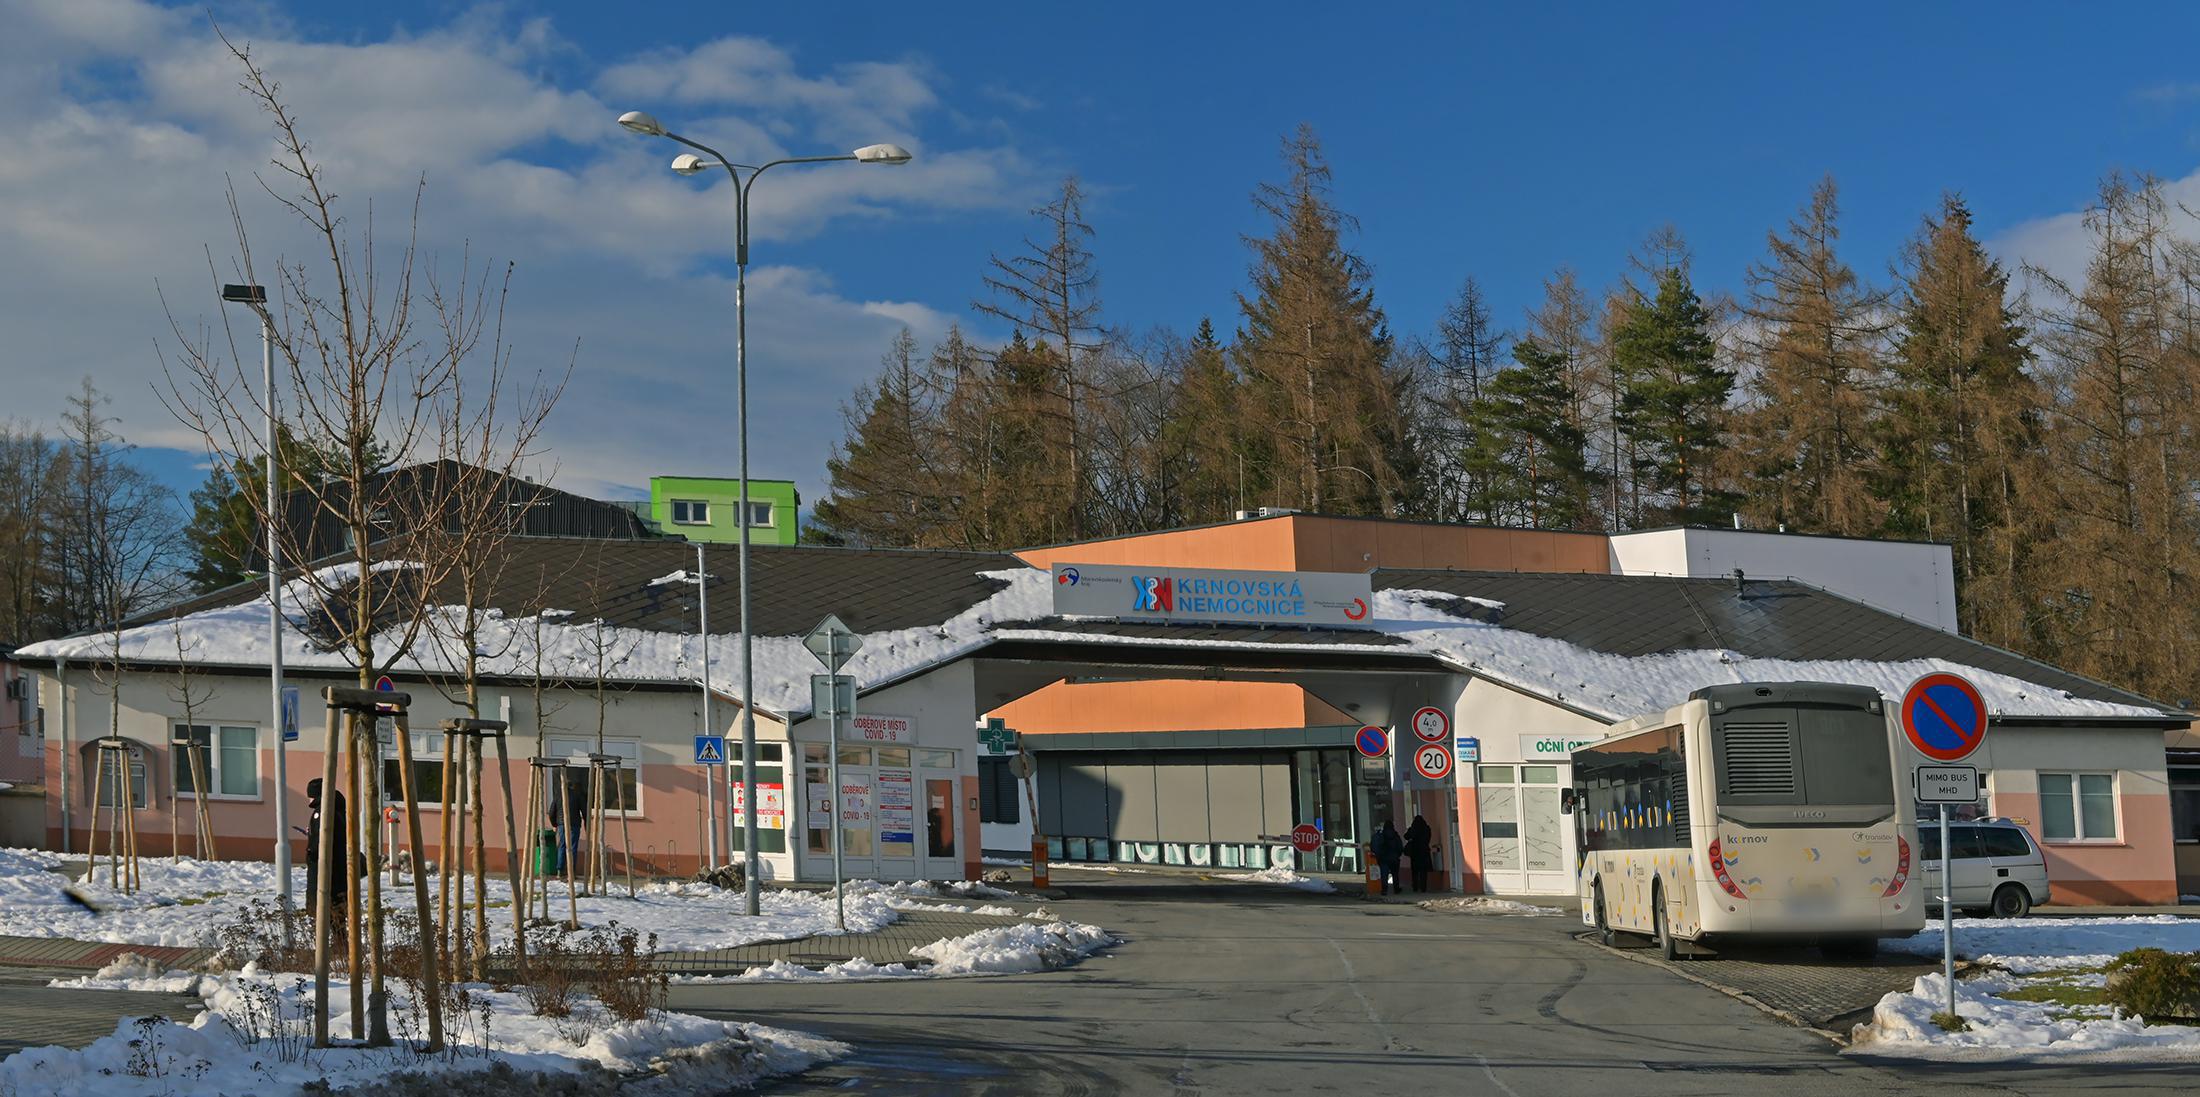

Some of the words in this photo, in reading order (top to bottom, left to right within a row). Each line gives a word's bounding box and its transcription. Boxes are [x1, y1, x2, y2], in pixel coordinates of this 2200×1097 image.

[1178, 578, 1302, 597] KRNOVSKÁ
[1179, 597, 1305, 616] NEMOCNICE
[853, 716, 887, 730] ODBĚROVÉ
[887, 717, 907, 731] MÍSTO
[864, 729, 884, 740] COVID
[889, 731, 897, 740] 19
[1536, 738, 1565, 752] OČNÍ
[1423, 753, 1444, 770] 20
[1926, 774, 1948, 782] MIMO
[1950, 774, 1968, 782] BUS
[842, 810, 860, 821] COVID
[863, 811, 870, 821] 19
[1793, 809, 1826, 818] IVECO
[1293, 832, 1320, 845] STOP
